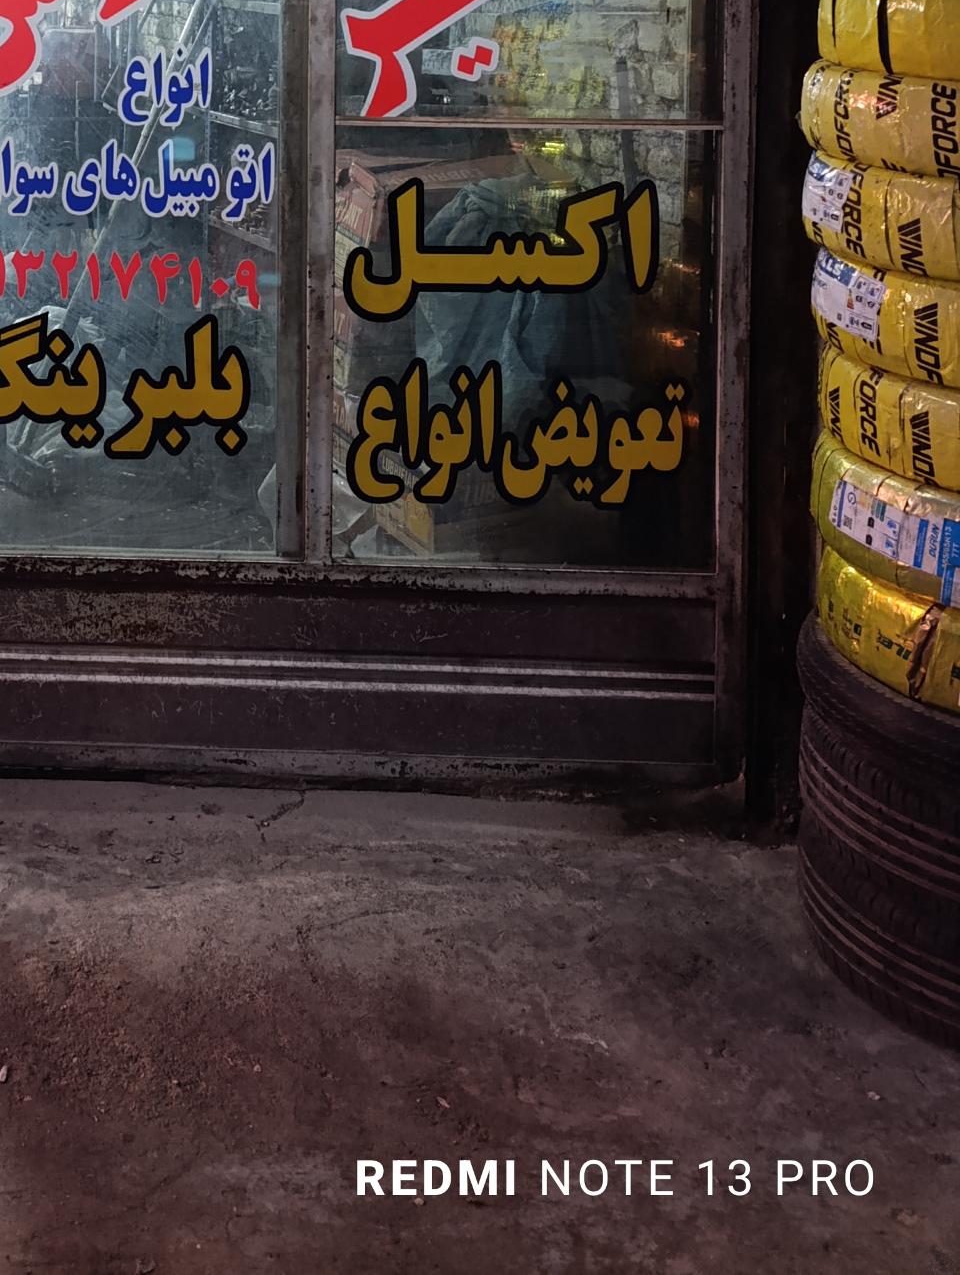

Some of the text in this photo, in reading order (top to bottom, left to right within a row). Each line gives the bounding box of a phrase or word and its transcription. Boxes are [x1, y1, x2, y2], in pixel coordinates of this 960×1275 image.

[118, 47, 212, 125] انواع
[343, 177, 659, 322] اکسل
[346, 357, 692, 509] تعویض انواع
